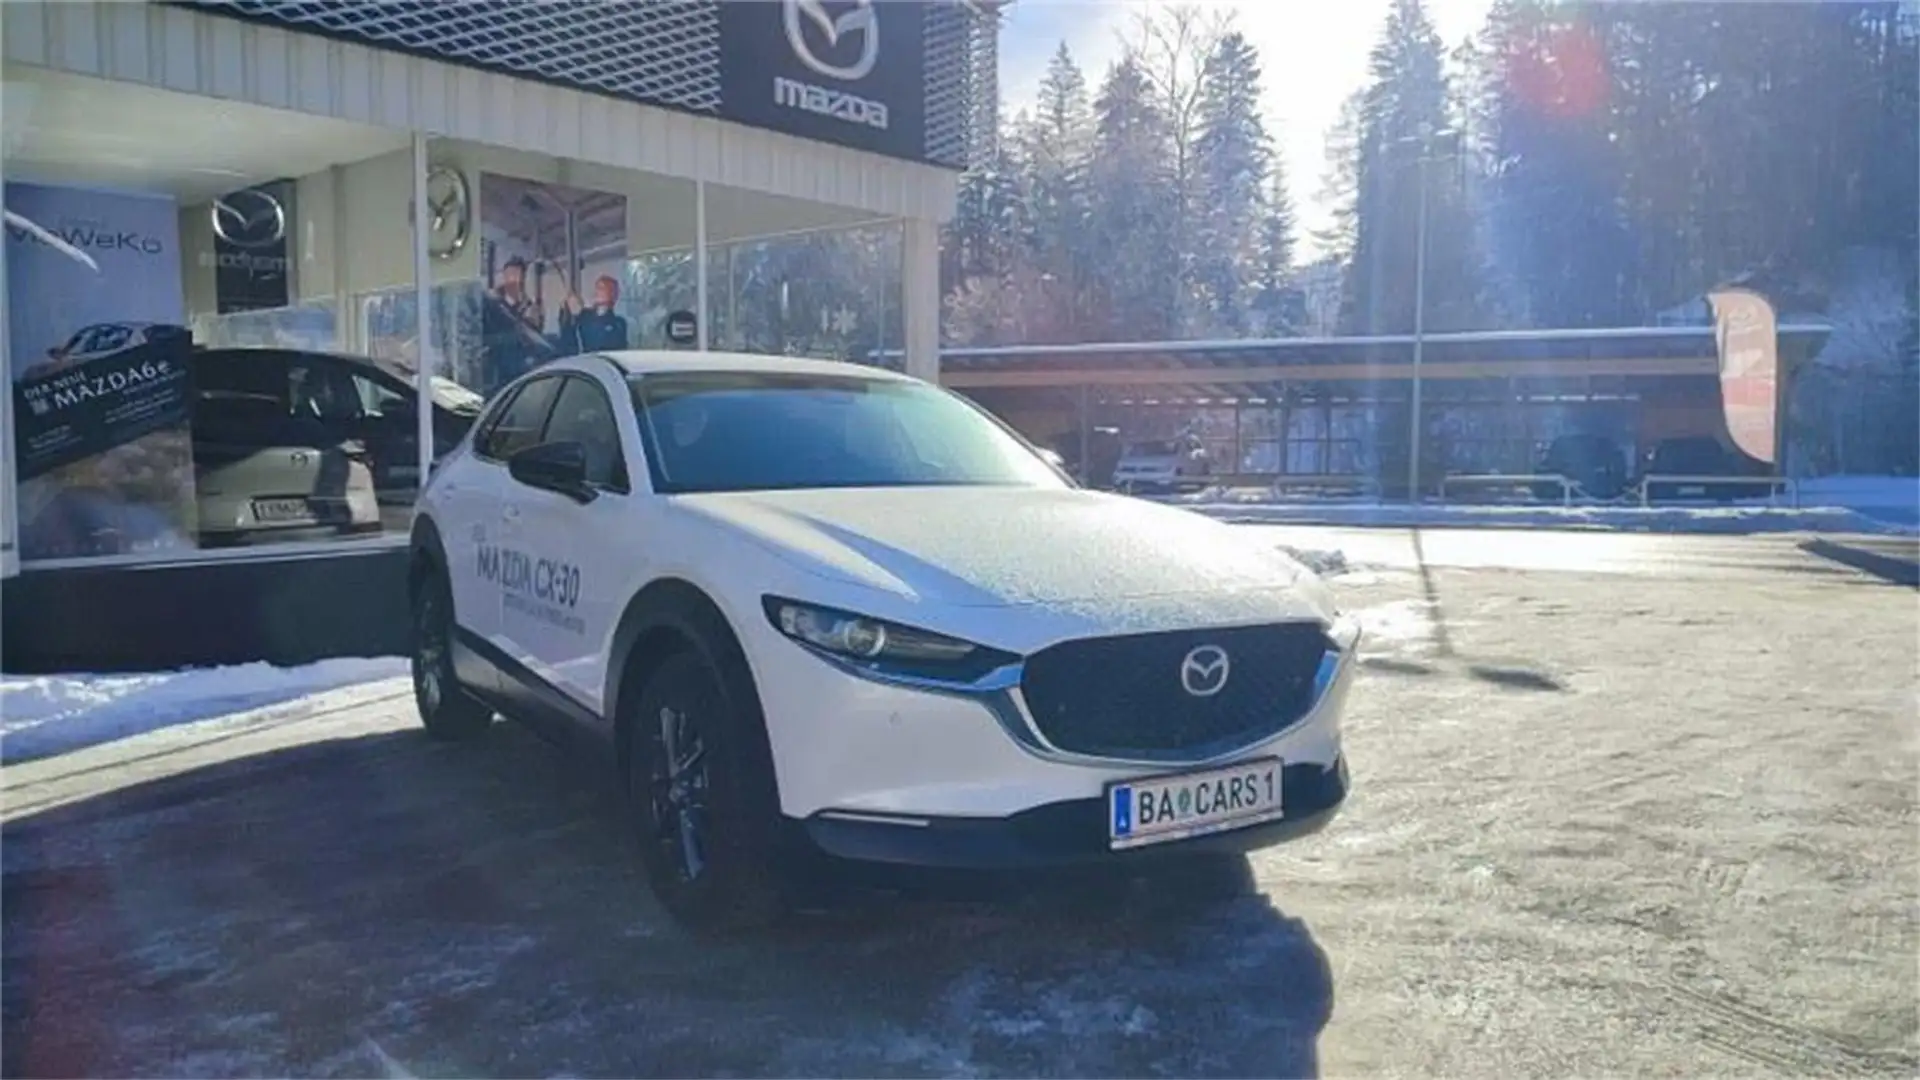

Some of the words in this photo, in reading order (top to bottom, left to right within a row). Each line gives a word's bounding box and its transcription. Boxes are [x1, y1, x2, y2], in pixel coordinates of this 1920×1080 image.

[774, 77, 888, 129] mazda
[54, 360, 171, 410] MAZDA6e
[477, 545, 532, 595] MAZDA
[534, 557, 581, 609] CX-30
[1139, 787, 1175, 825] BA
[1195, 773, 1258, 816] CARS
[1264, 771, 1274, 801] 1
